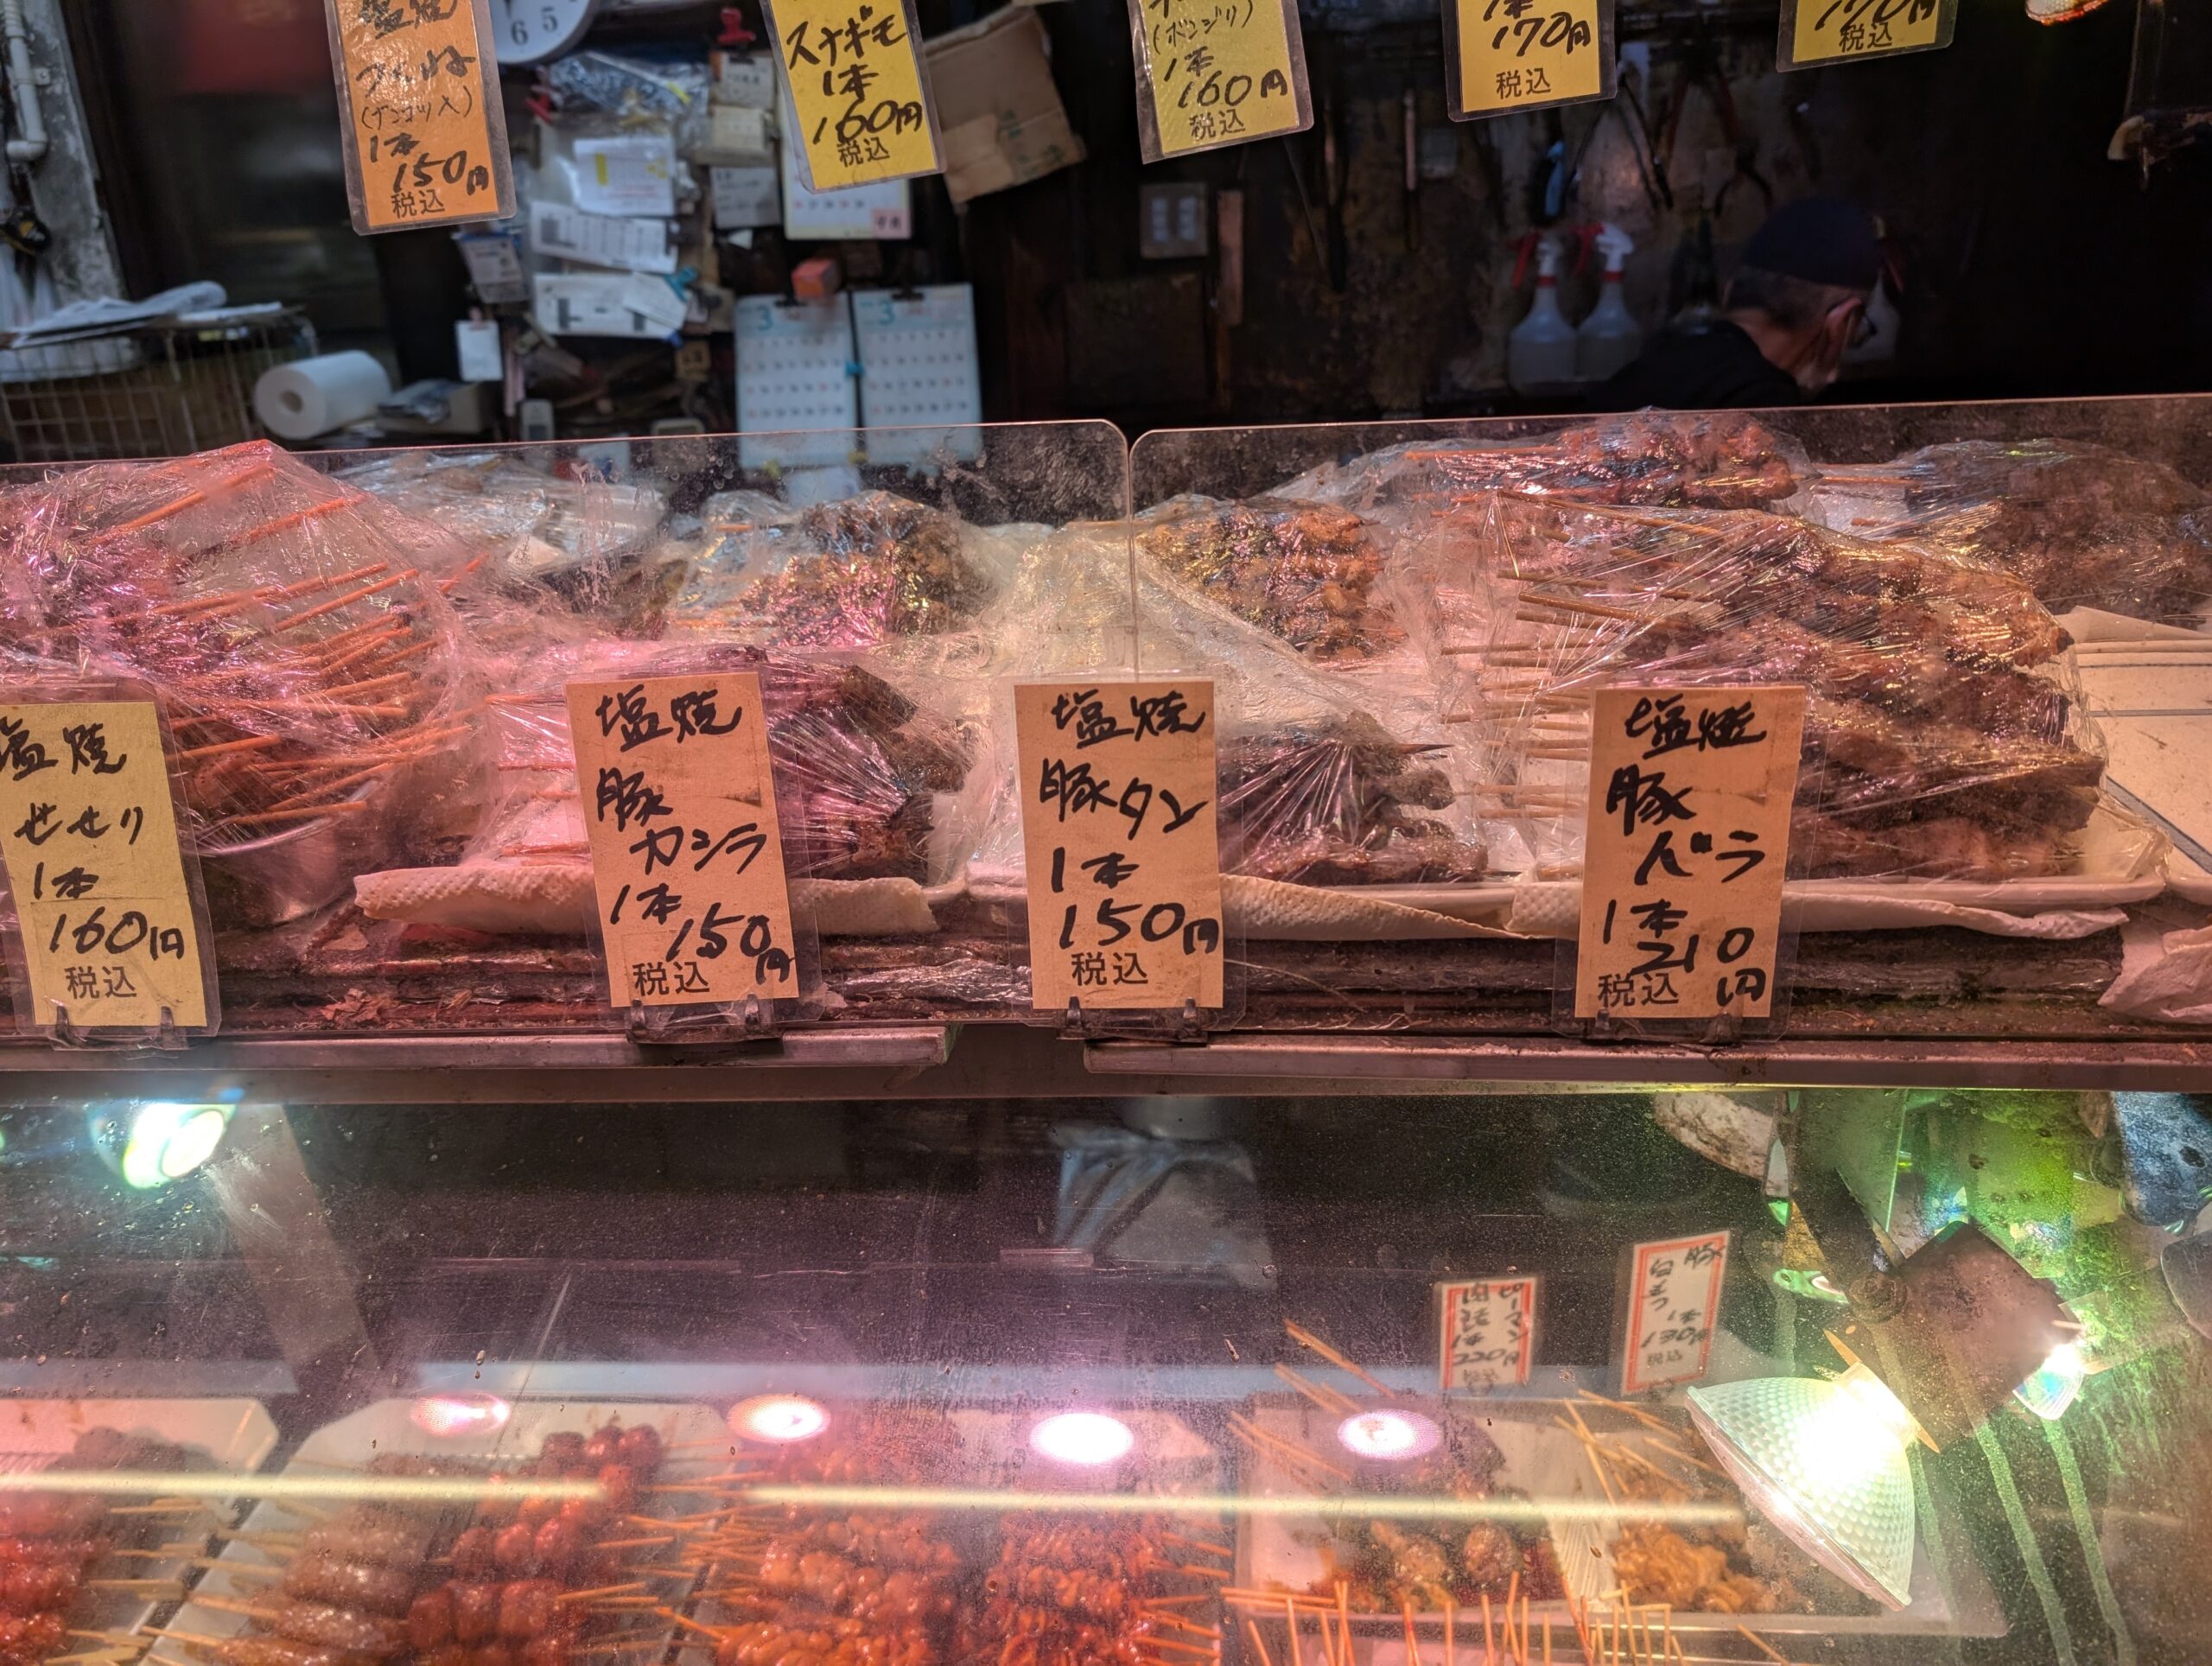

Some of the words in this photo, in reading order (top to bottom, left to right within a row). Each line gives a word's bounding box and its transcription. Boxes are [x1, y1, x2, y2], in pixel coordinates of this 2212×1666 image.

[512, 20, 529, 45] 6
[542, 7, 558, 33] 5
[786, 5, 908, 70] スナギモ
[1491, 11, 1592, 57] 170円
[1839, 22, 1892, 53] 税込
[822, 63, 880, 101] 1本
[1163, 46, 1215, 82] 1本
[1496, 67, 1552, 99] 税込
[1178, 68, 1288, 109] 160円
[812, 99, 923, 145] 160円
[1189, 109, 1246, 141] 税込
[371, 132, 420, 163] 1本
[836, 136, 891, 168] 税込
[392, 150, 490, 195] 150円
[391, 189, 446, 219] 税込
[595, 684, 742, 752] 塩焼
[1051, 689, 1205, 749] 塩焼
[1625, 693, 1767, 759] 塩焼
[595, 767, 673, 832] 豚
[1039, 758, 1209, 841] 豚タン
[1605, 763, 1697, 836] 豚
[15, 802, 143, 846] せせり
[630, 823, 767, 875] カシラ
[1051, 847, 1140, 893] 1本
[1634, 830, 1766, 885] バラ
[33, 862, 99, 900] 1本
[610, 883, 682, 924] 1本
[1604, 899, 1688, 944] 1本
[49, 906, 185, 962] 160円
[1059, 898, 1219, 956] 150円
[65, 965, 137, 1000] 税込
[632, 961, 710, 996] 税込
[1071, 951, 1149, 987] 税込
[1598, 973, 1680, 1007] 税込
